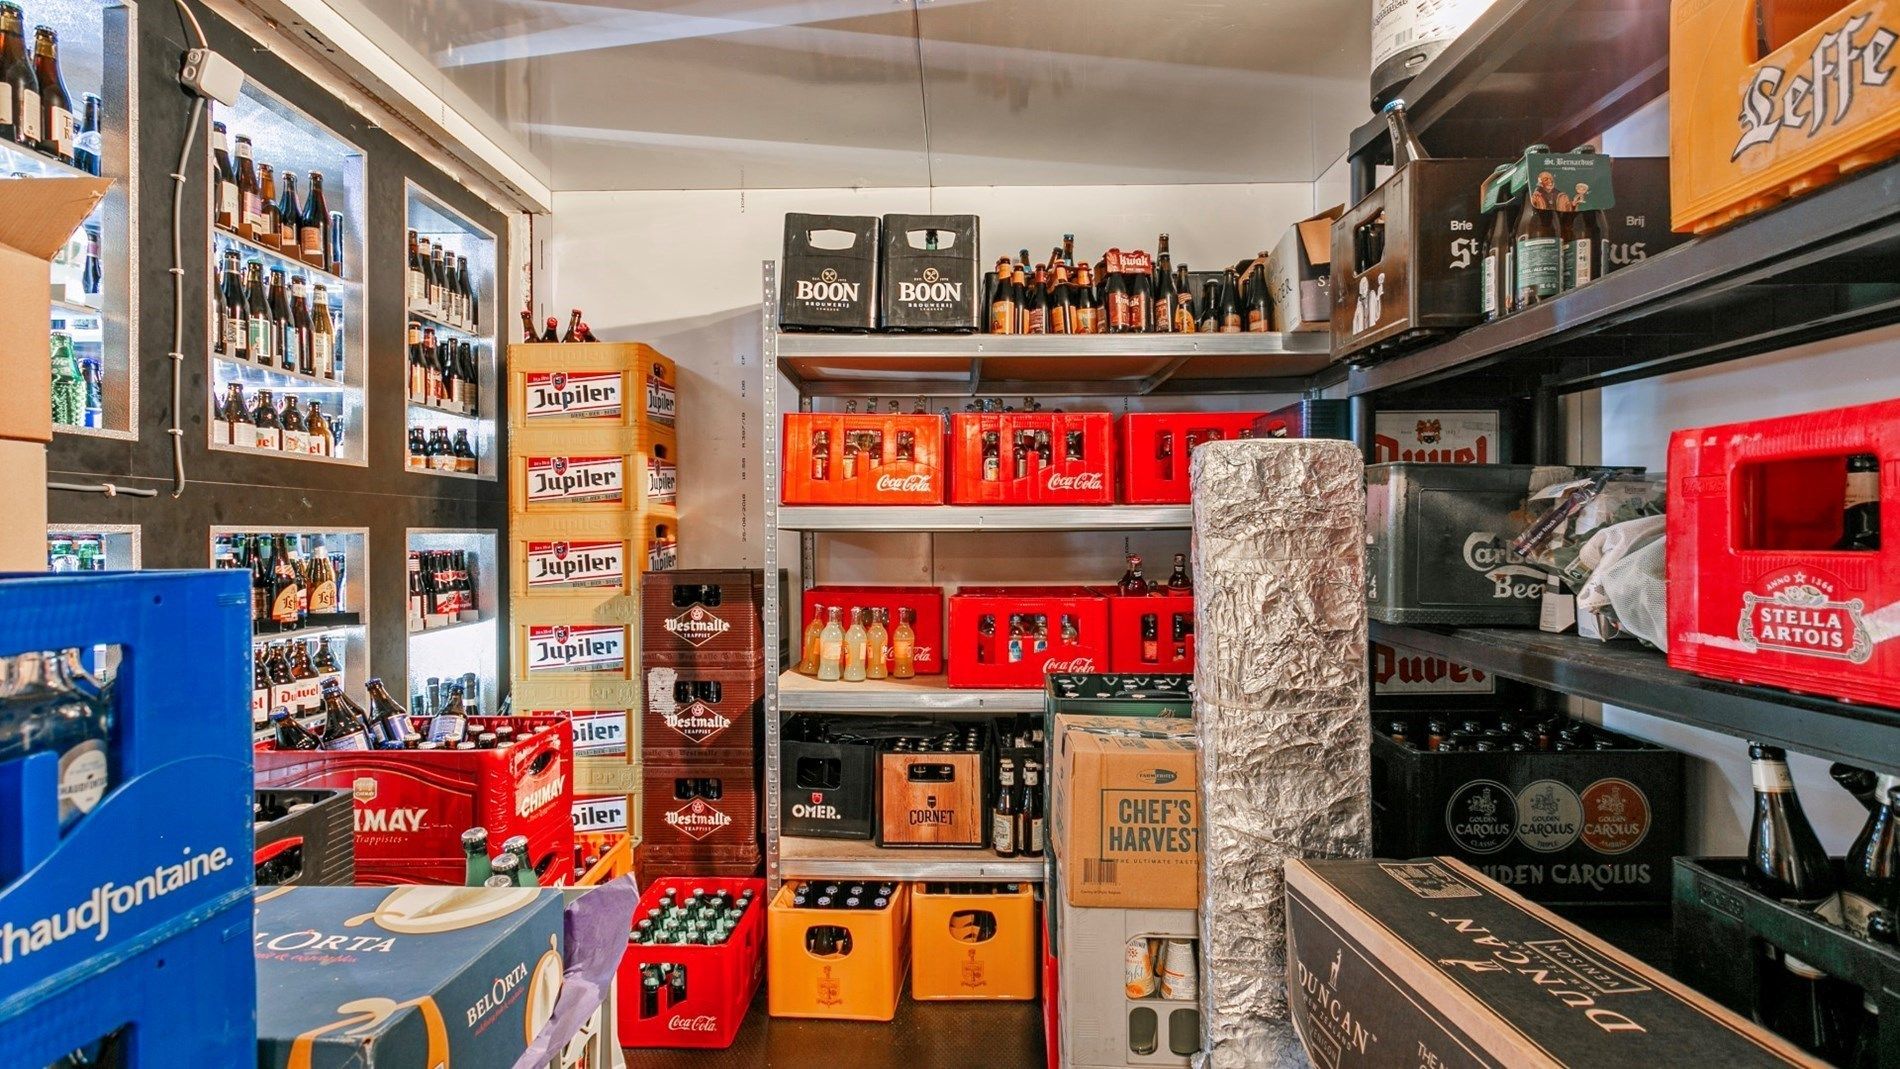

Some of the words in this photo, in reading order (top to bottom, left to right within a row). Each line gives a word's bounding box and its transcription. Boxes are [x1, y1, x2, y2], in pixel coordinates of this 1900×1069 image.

[1730, 12, 1900, 163] Leffe
[1450, 220, 1473, 231] Brie
[1626, 215, 1645, 228] Brij
[1450, 237, 1479, 269] St
[796, 280, 861, 302] BOON
[898, 282, 963, 302] BOON
[534, 384, 616, 410] Jupiler
[648, 390, 674, 412] Jupiler
[535, 469, 616, 494] Jupiler
[650, 473, 675, 494] Jupiler
[876, 473, 932, 492] Coca-Cola
[1047, 472, 1103, 490] Coca-Cola
[536, 553, 617, 579] Jupiler
[1766, 575, 1791, 592] ANNO
[1811, 576, 1834, 593] 1366
[664, 618, 731, 632] Westmalle
[1760, 608, 1843, 630] STELLA
[1761, 623, 1844, 648] ARTOIS
[537, 637, 618, 662] Jupiler
[664, 714, 732, 728] Westmalle
[573, 723, 620, 742] iler
[521, 775, 565, 818] CHIMAY
[354, 808, 429, 832] IMAY
[573, 807, 621, 826] iler
[664, 811, 732, 825] Westmalle
[792, 804, 841, 820] OMER.
[909, 809, 955, 827] CORNET
[1118, 798, 1192, 825] CHEF'S
[1531, 815, 1560, 823] GOLDEN
[1598, 815, 1627, 823] GOLDEN
[1455, 823, 1510, 839] CAROLUS
[1520, 823, 1575, 838] CAROLUS
[1584, 823, 1640, 838] CAROLUS
[356, 835, 402, 846] Trappistes
[1470, 839, 1498, 848] CLASSIC
[1551, 864, 1651, 891] CAROLUS
[1440, 917, 1647, 1032] DUNCAN
[1544, 944, 1621, 988] VENISON
[1297, 959, 1370, 1055] DUNCAN
[668, 1014, 717, 1032] Coca-Cola
[1309, 1026, 1337, 1060] VENISON
